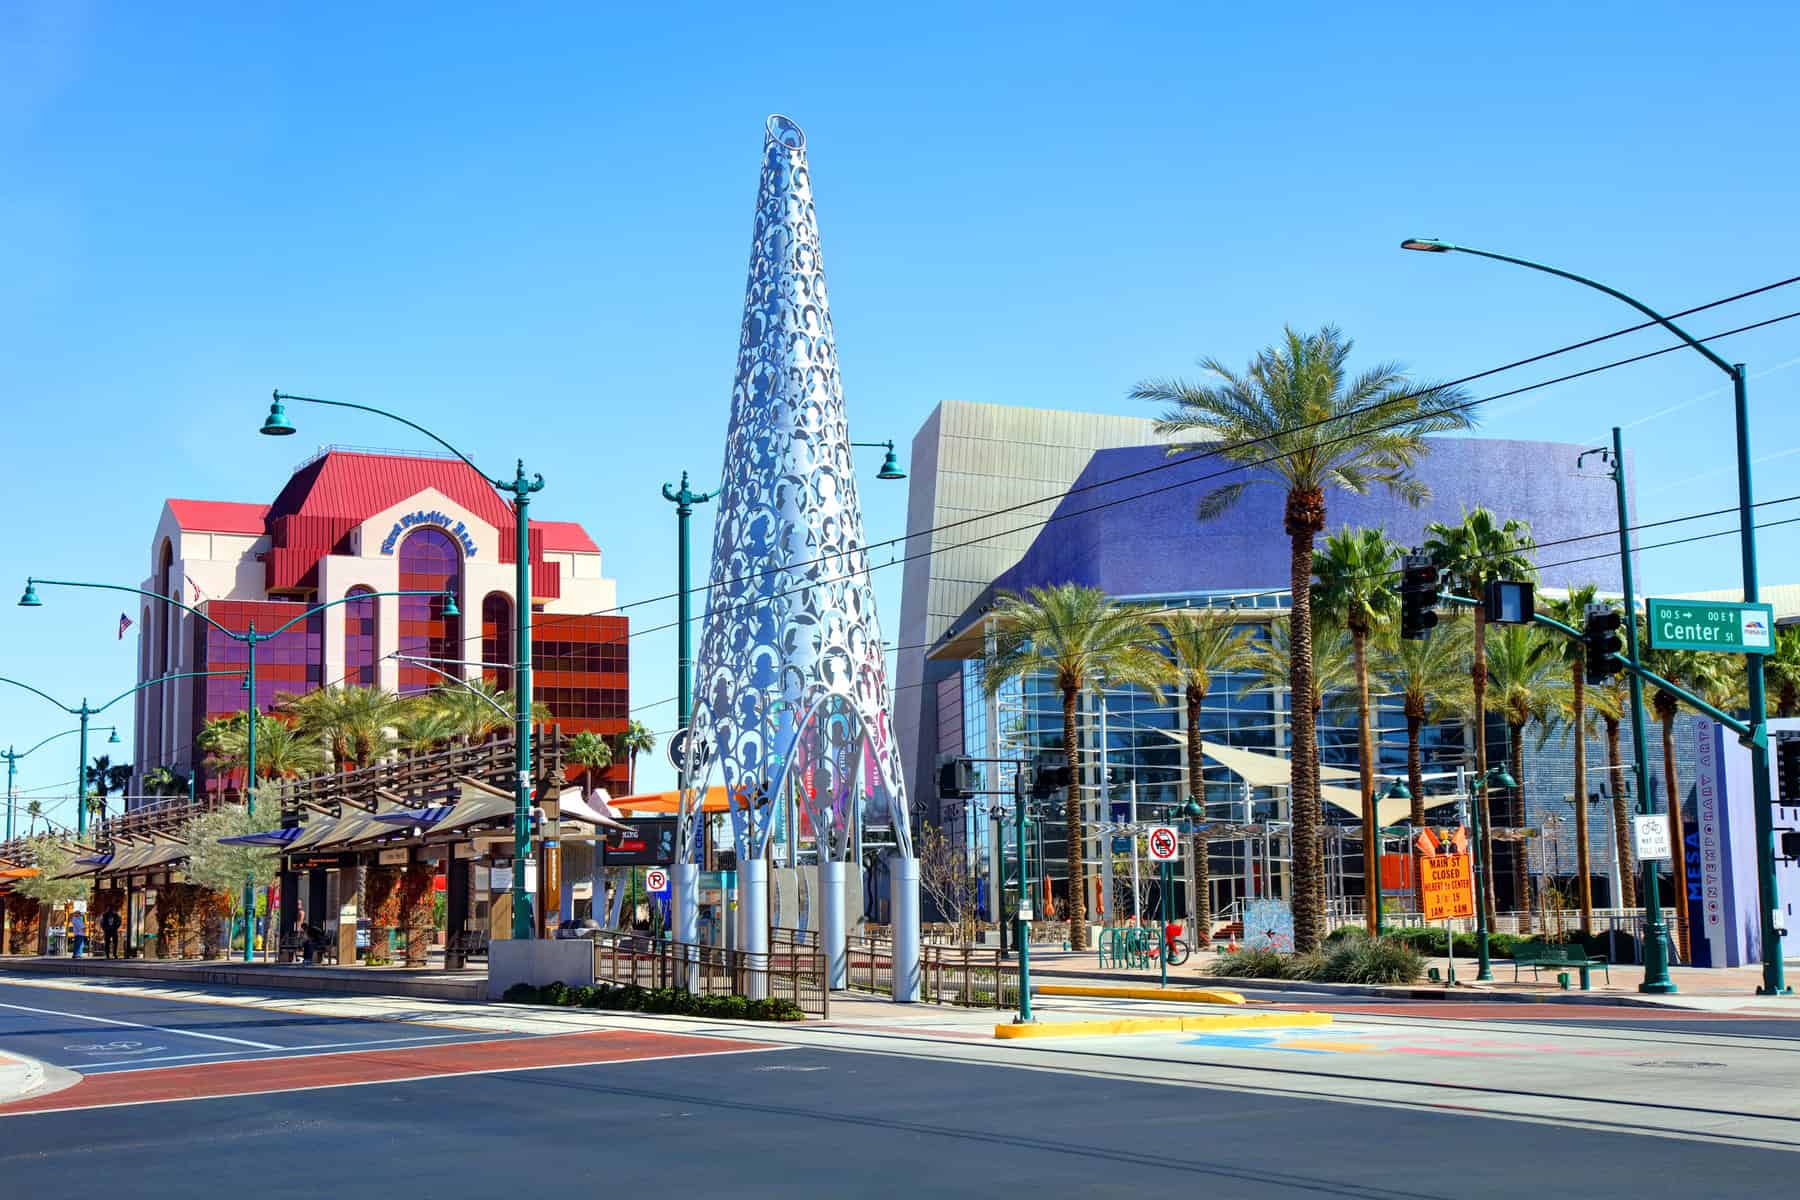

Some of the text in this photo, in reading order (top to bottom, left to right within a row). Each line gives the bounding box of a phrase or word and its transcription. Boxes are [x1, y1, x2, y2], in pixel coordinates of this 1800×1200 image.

[381, 511, 478, 557] First Fidelity Bank
[1721, 612, 1726, 622] E
[1664, 622, 1720, 641] Center
[1698, 721, 1719, 924] CONTEMPORARY ARTS
[1430, 857, 1460, 868] MAIN ST
[1687, 831, 1702, 901] MESA
[1432, 869, 1460, 880] CLOSED
[1451, 880, 1469, 890] CENTER
